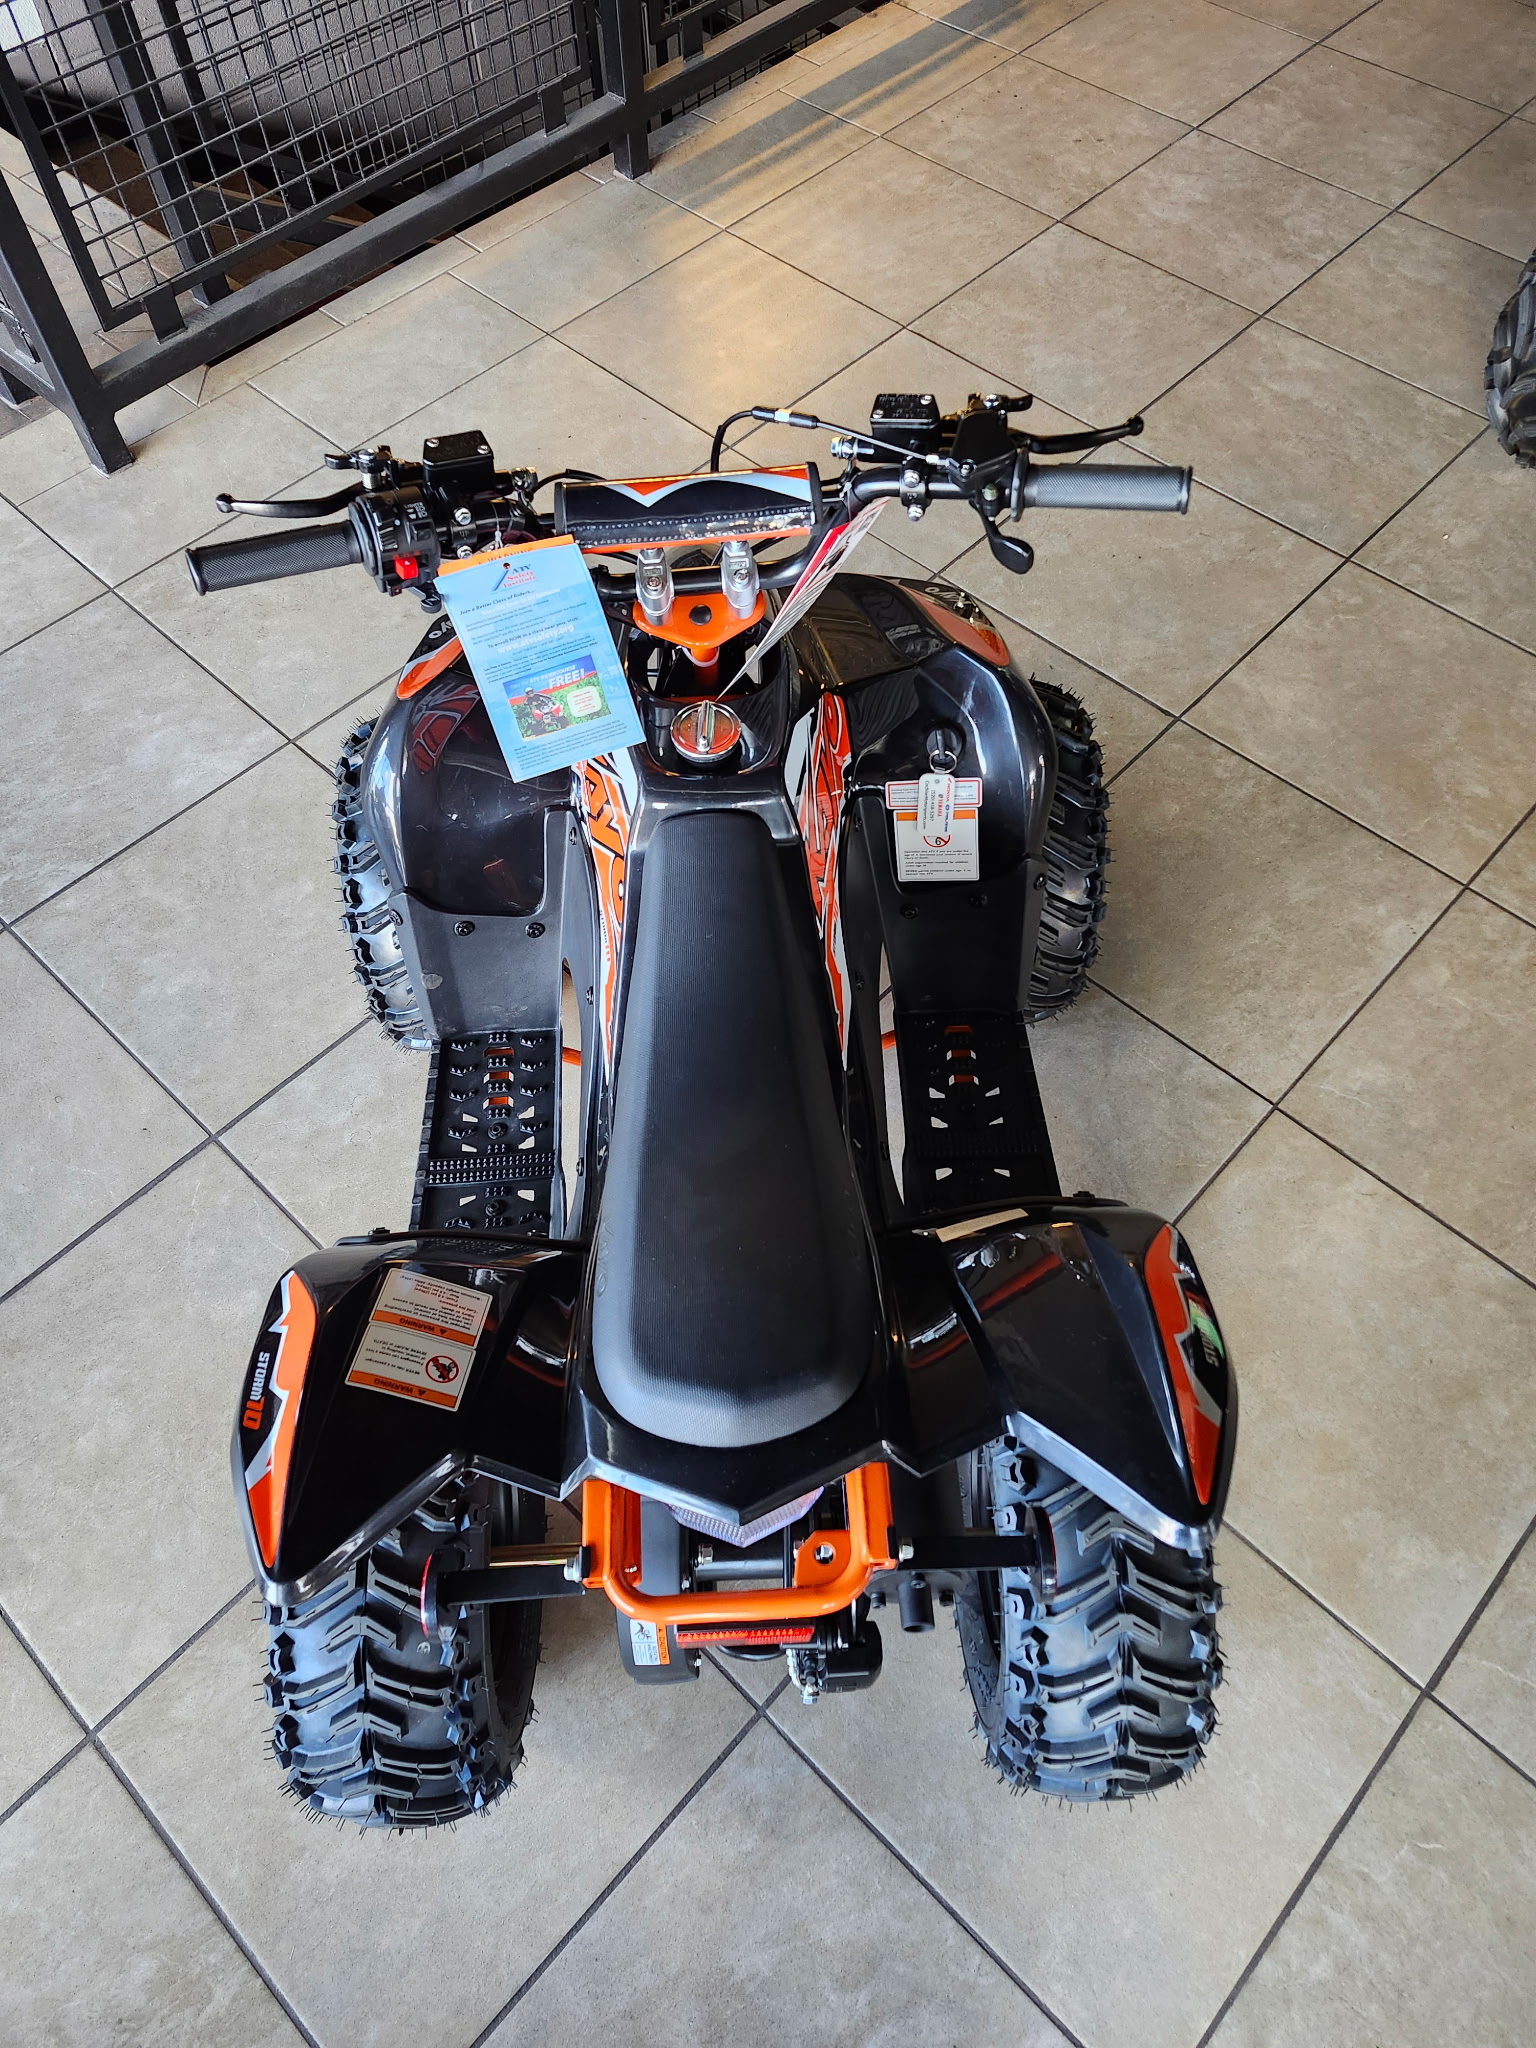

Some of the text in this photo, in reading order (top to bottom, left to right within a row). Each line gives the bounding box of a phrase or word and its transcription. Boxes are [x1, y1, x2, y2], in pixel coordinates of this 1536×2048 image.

[506, 570, 534, 582] Safety
[510, 564, 532, 575] ATV
[503, 575, 538, 588] Institute
[496, 624, 575, 654] www.atvsafety.org
[508, 634, 522, 642] NOW
[528, 675, 540, 684] ATV
[546, 667, 587, 690] FREE!
[398, 1317, 436, 1333] WARNING
[409, 1348, 428, 1356] SEVERE
[242, 1350, 270, 1431] STORM 70
[372, 1377, 415, 1394] WARNING
